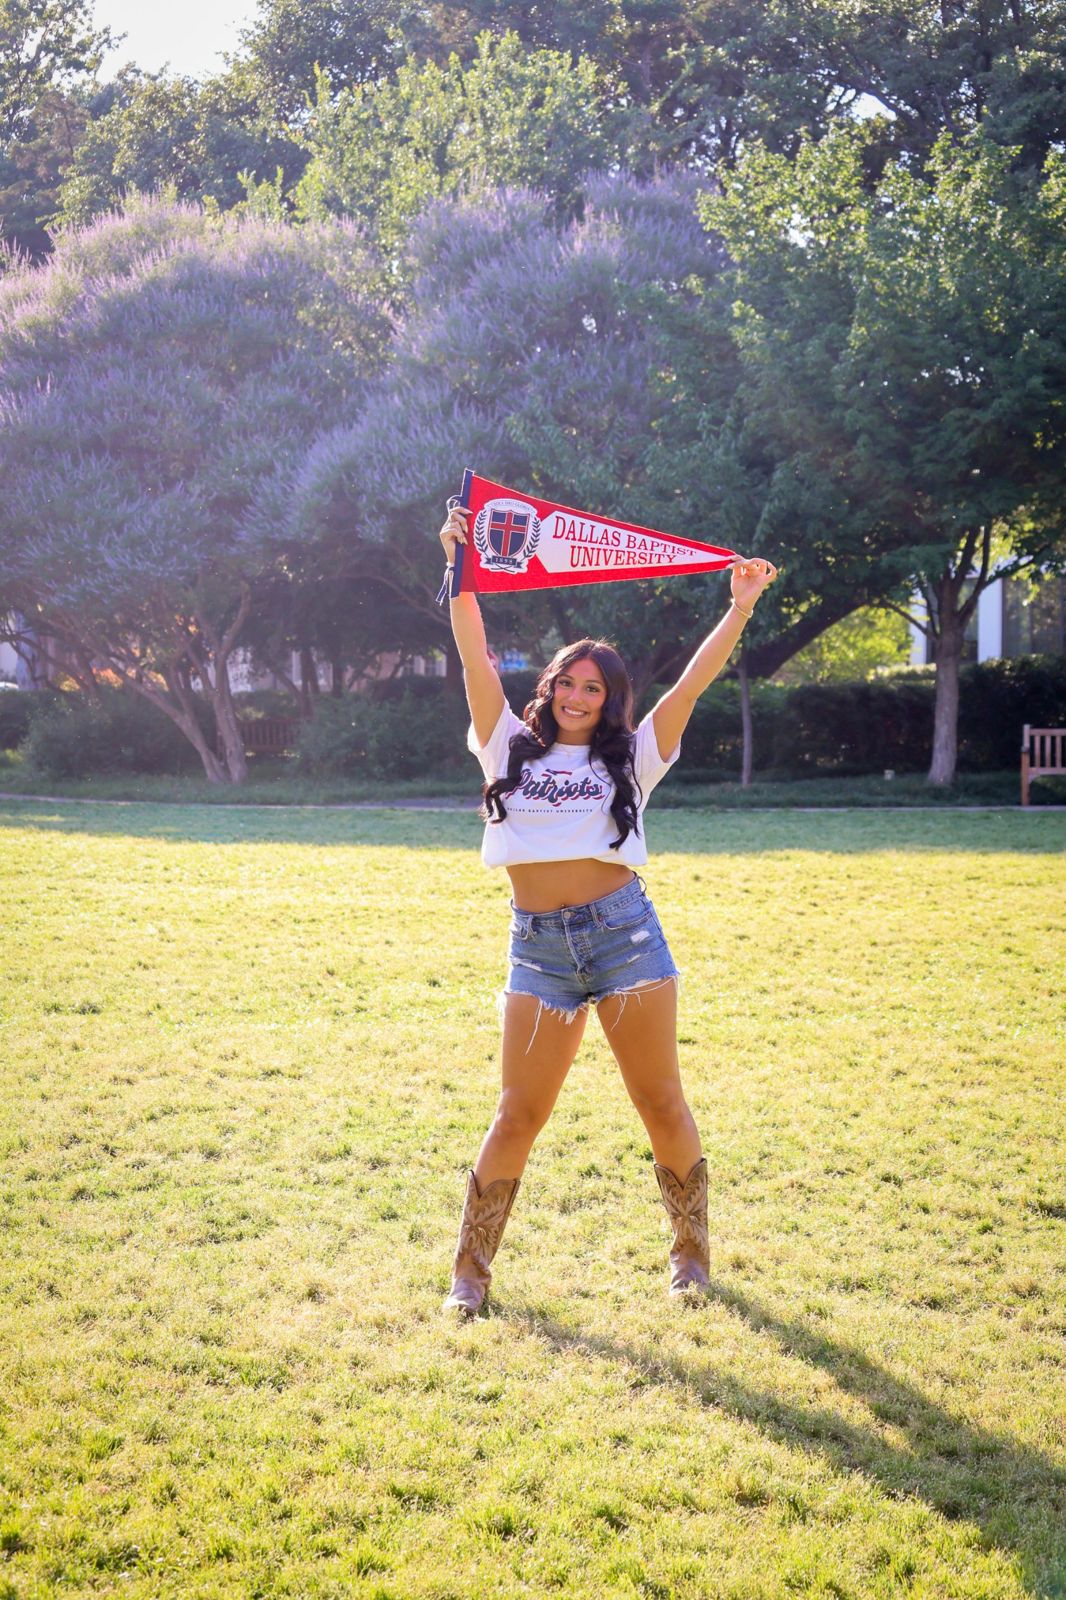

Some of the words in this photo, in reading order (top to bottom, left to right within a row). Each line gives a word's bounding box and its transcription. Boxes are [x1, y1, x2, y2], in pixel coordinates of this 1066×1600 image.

[552, 515, 621, 547] DALLAS
[625, 534, 697, 557] BAPTIST
[570, 545, 677, 568] UNIVERSITY
[506, 768, 605, 807] Patriots
